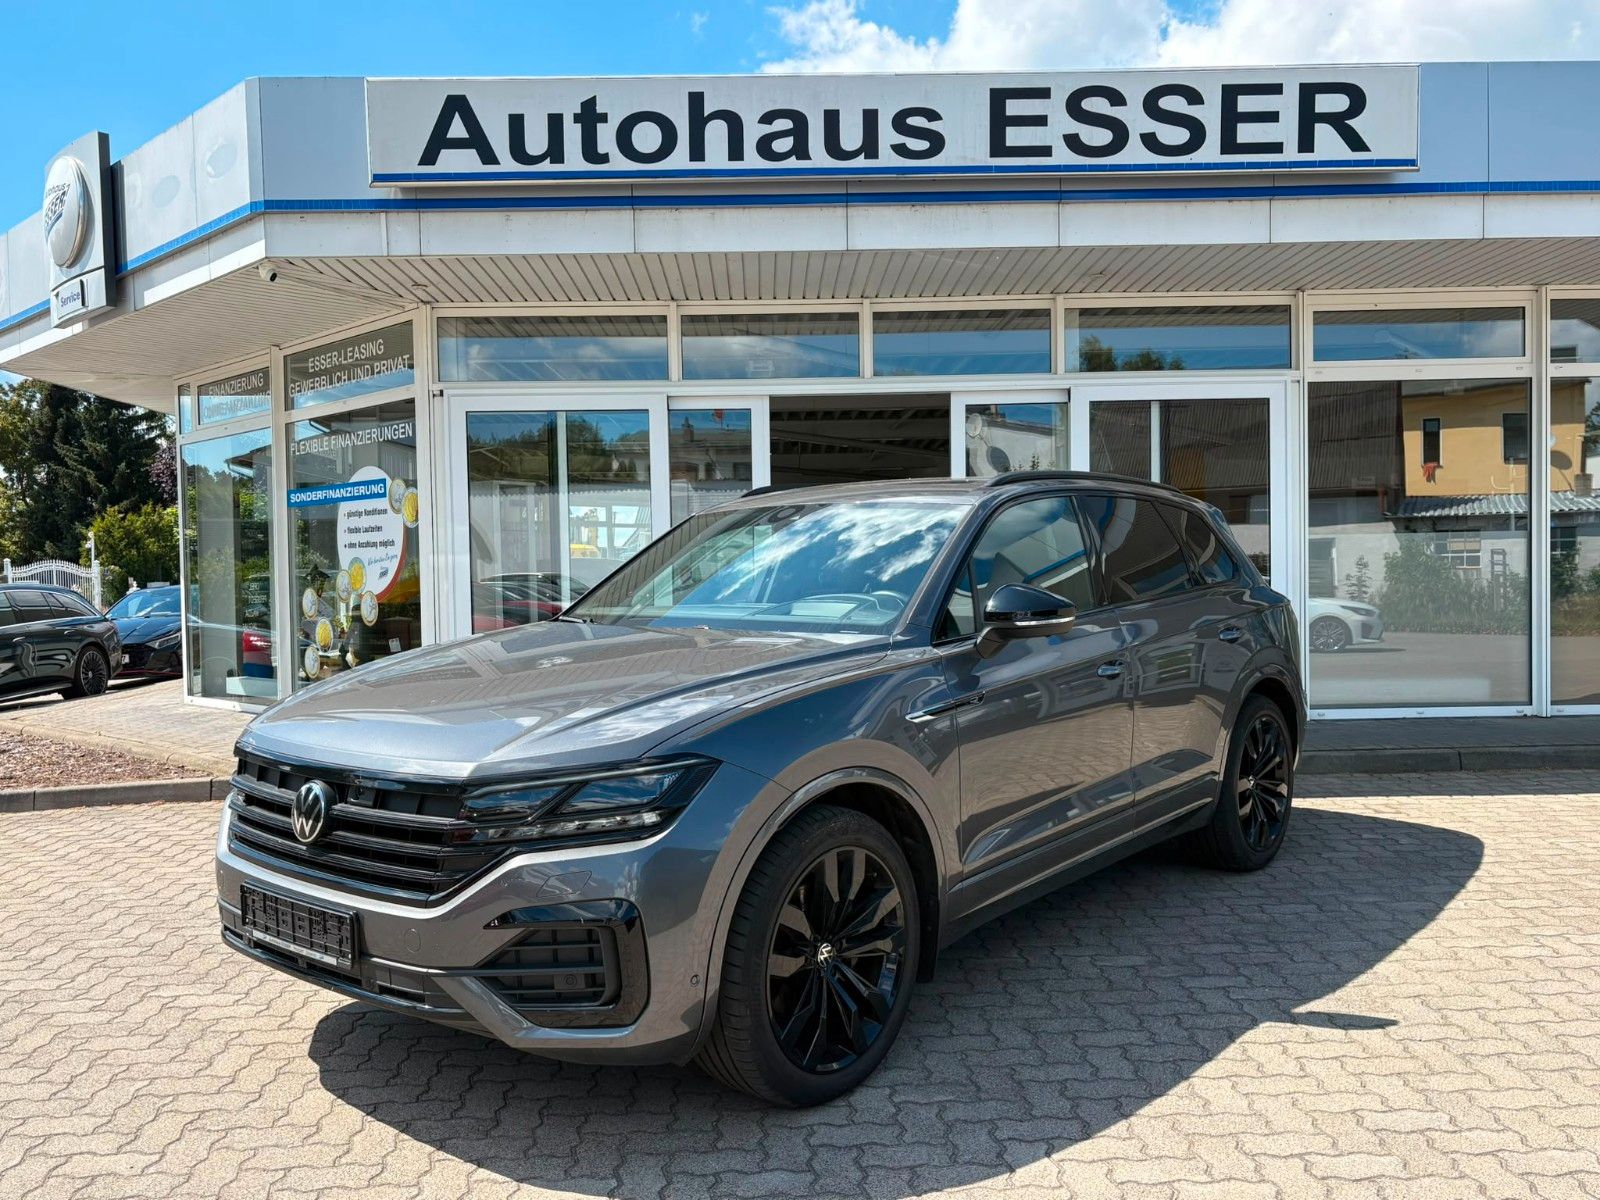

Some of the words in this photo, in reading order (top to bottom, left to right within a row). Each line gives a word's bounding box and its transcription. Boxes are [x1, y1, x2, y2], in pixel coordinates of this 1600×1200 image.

[417, 91, 947, 167] Autohaus
[988, 81, 1372, 159] ESSER
[60, 291, 81, 307] Service
[308, 339, 384, 373] ESSER-LEASING
[208, 373, 264, 399] FINANZIERUNG
[288, 370, 348, 398] GEWERBLICH
[350, 363, 373, 384] UND
[373, 354, 410, 380] PRIVAT
[290, 436, 329, 457] FLEXIBLE
[330, 422, 413, 451] FINANZIERUNGEN
[290, 484, 385, 503] SONDERFINANZIERUNG
